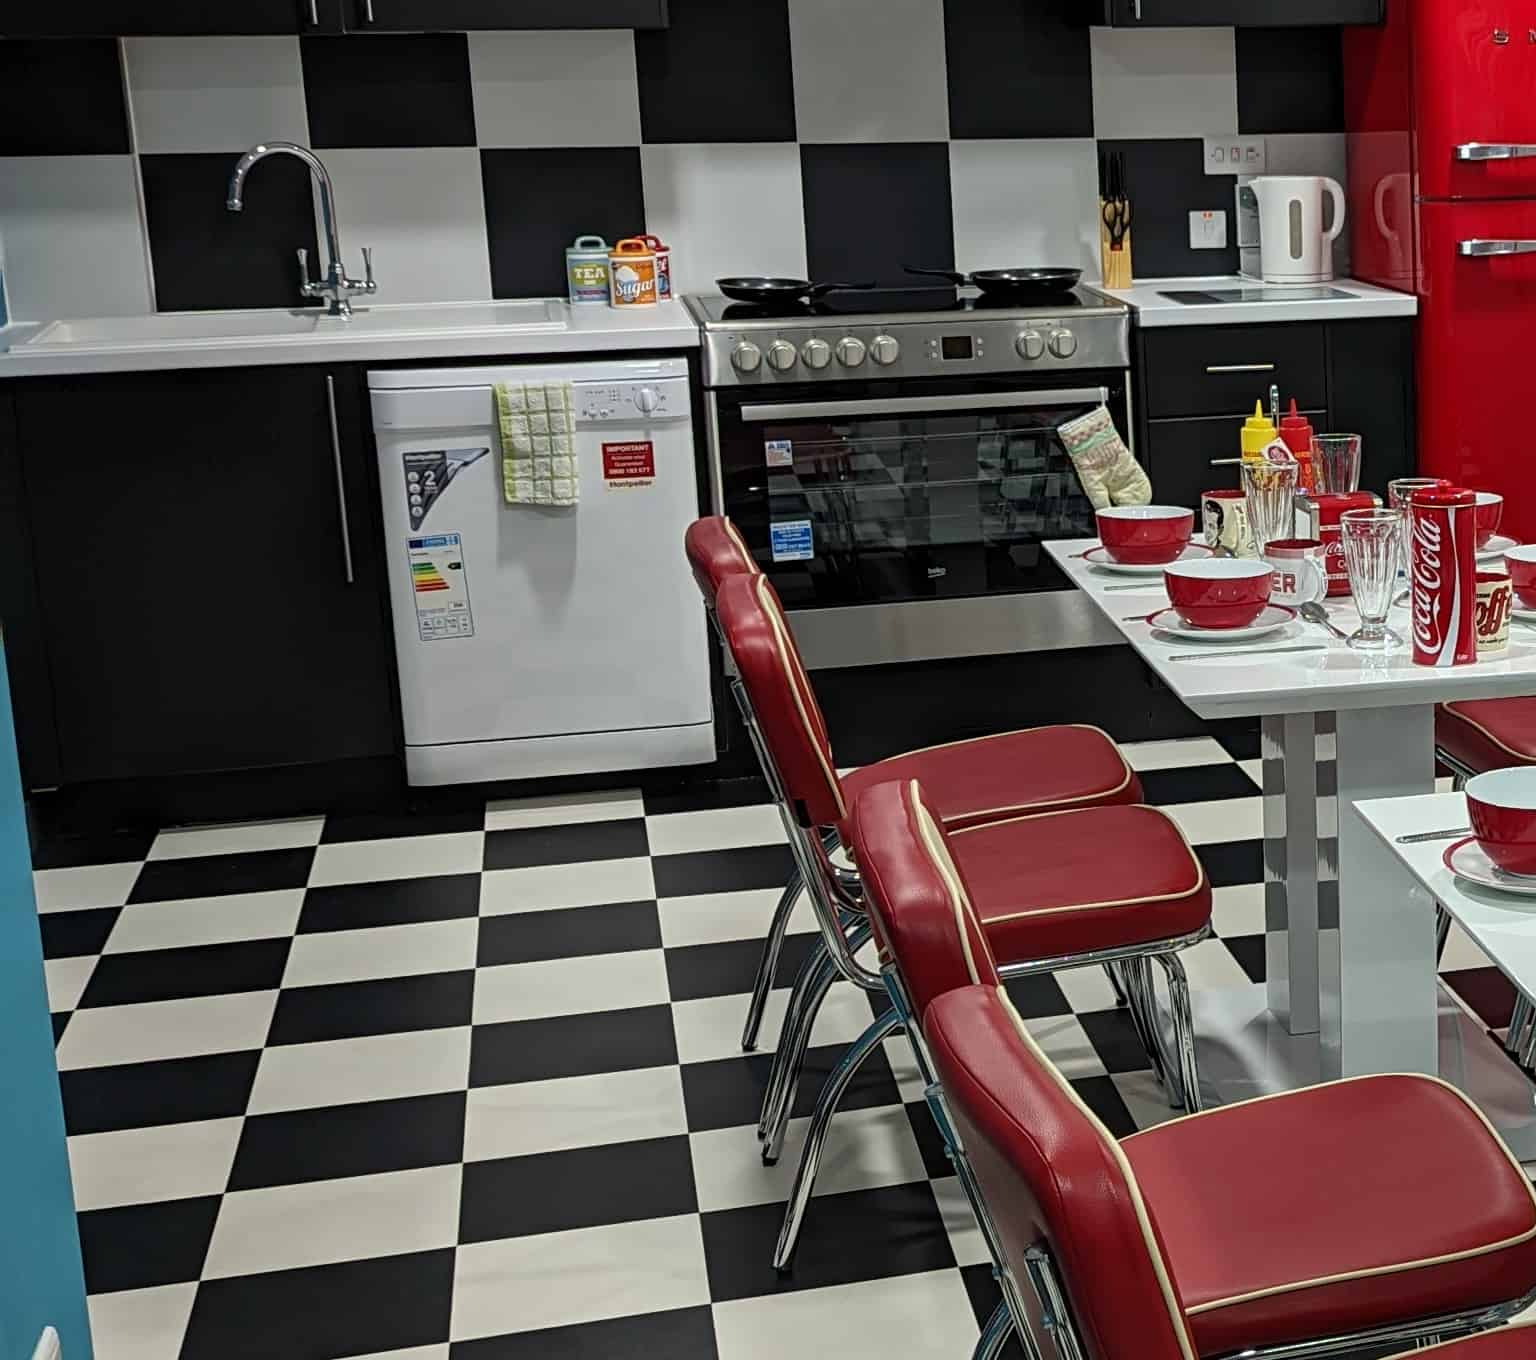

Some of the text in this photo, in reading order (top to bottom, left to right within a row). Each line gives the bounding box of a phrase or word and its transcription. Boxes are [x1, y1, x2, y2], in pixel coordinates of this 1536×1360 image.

[573, 266, 605, 279] TEA
[615, 279, 656, 298] Sugar
[424, 470, 437, 486] 2
[1412, 514, 1441, 654] Coca-Cola
